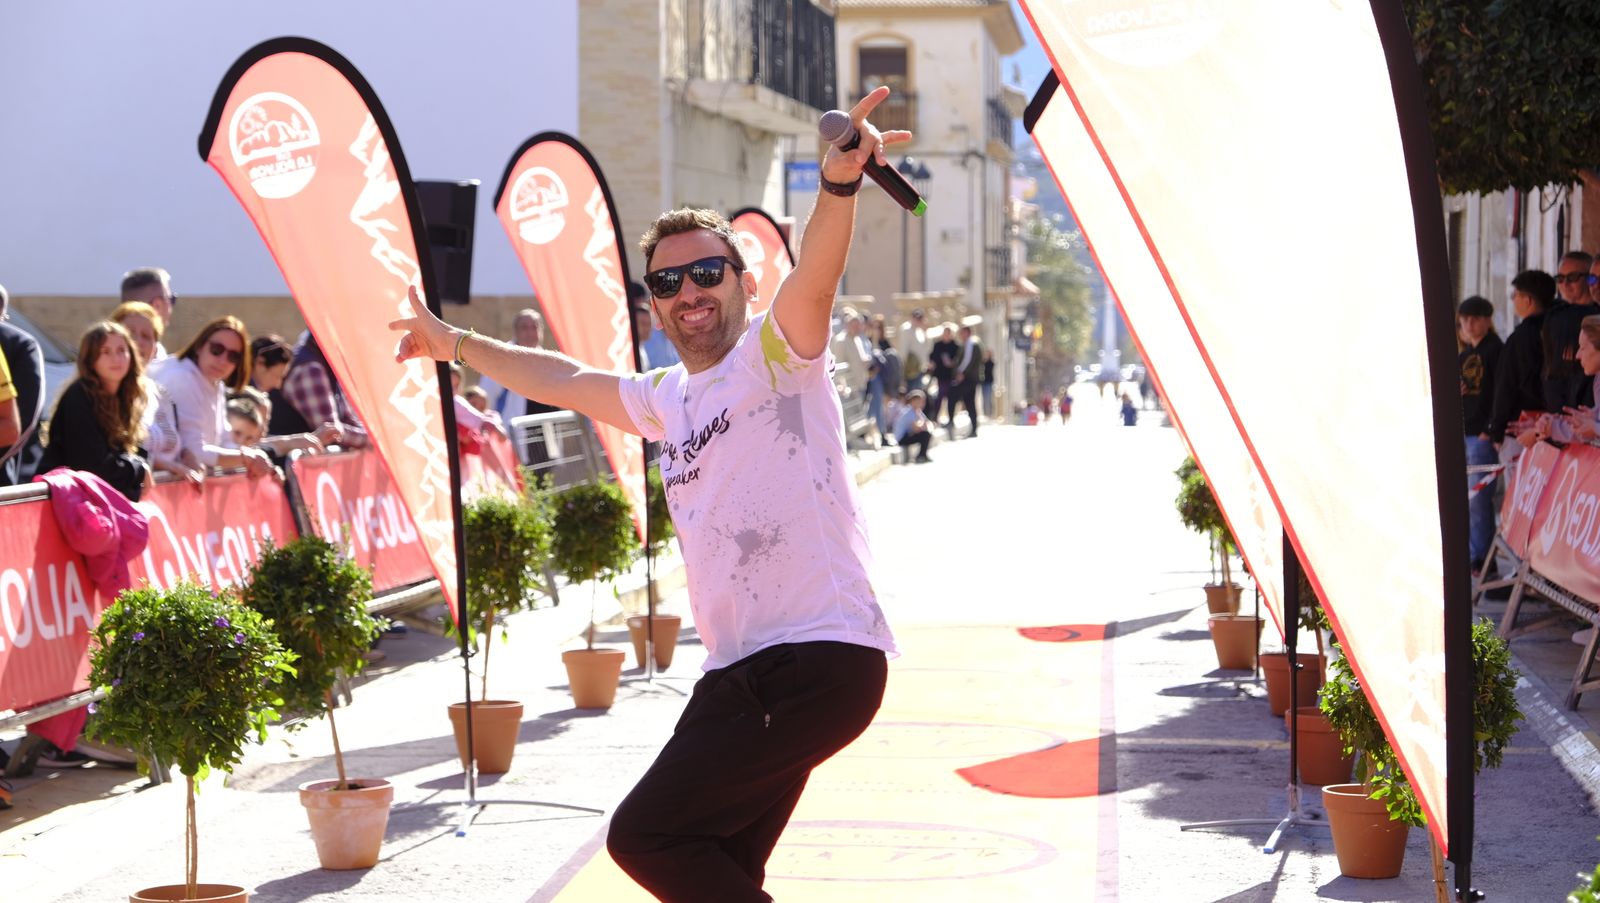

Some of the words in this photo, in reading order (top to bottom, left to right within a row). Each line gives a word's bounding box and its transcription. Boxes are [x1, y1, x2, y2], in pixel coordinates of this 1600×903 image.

[665, 467, 700, 497] peaker
[348, 493, 417, 553] VEOL
[0, 560, 95, 652] OLIA
